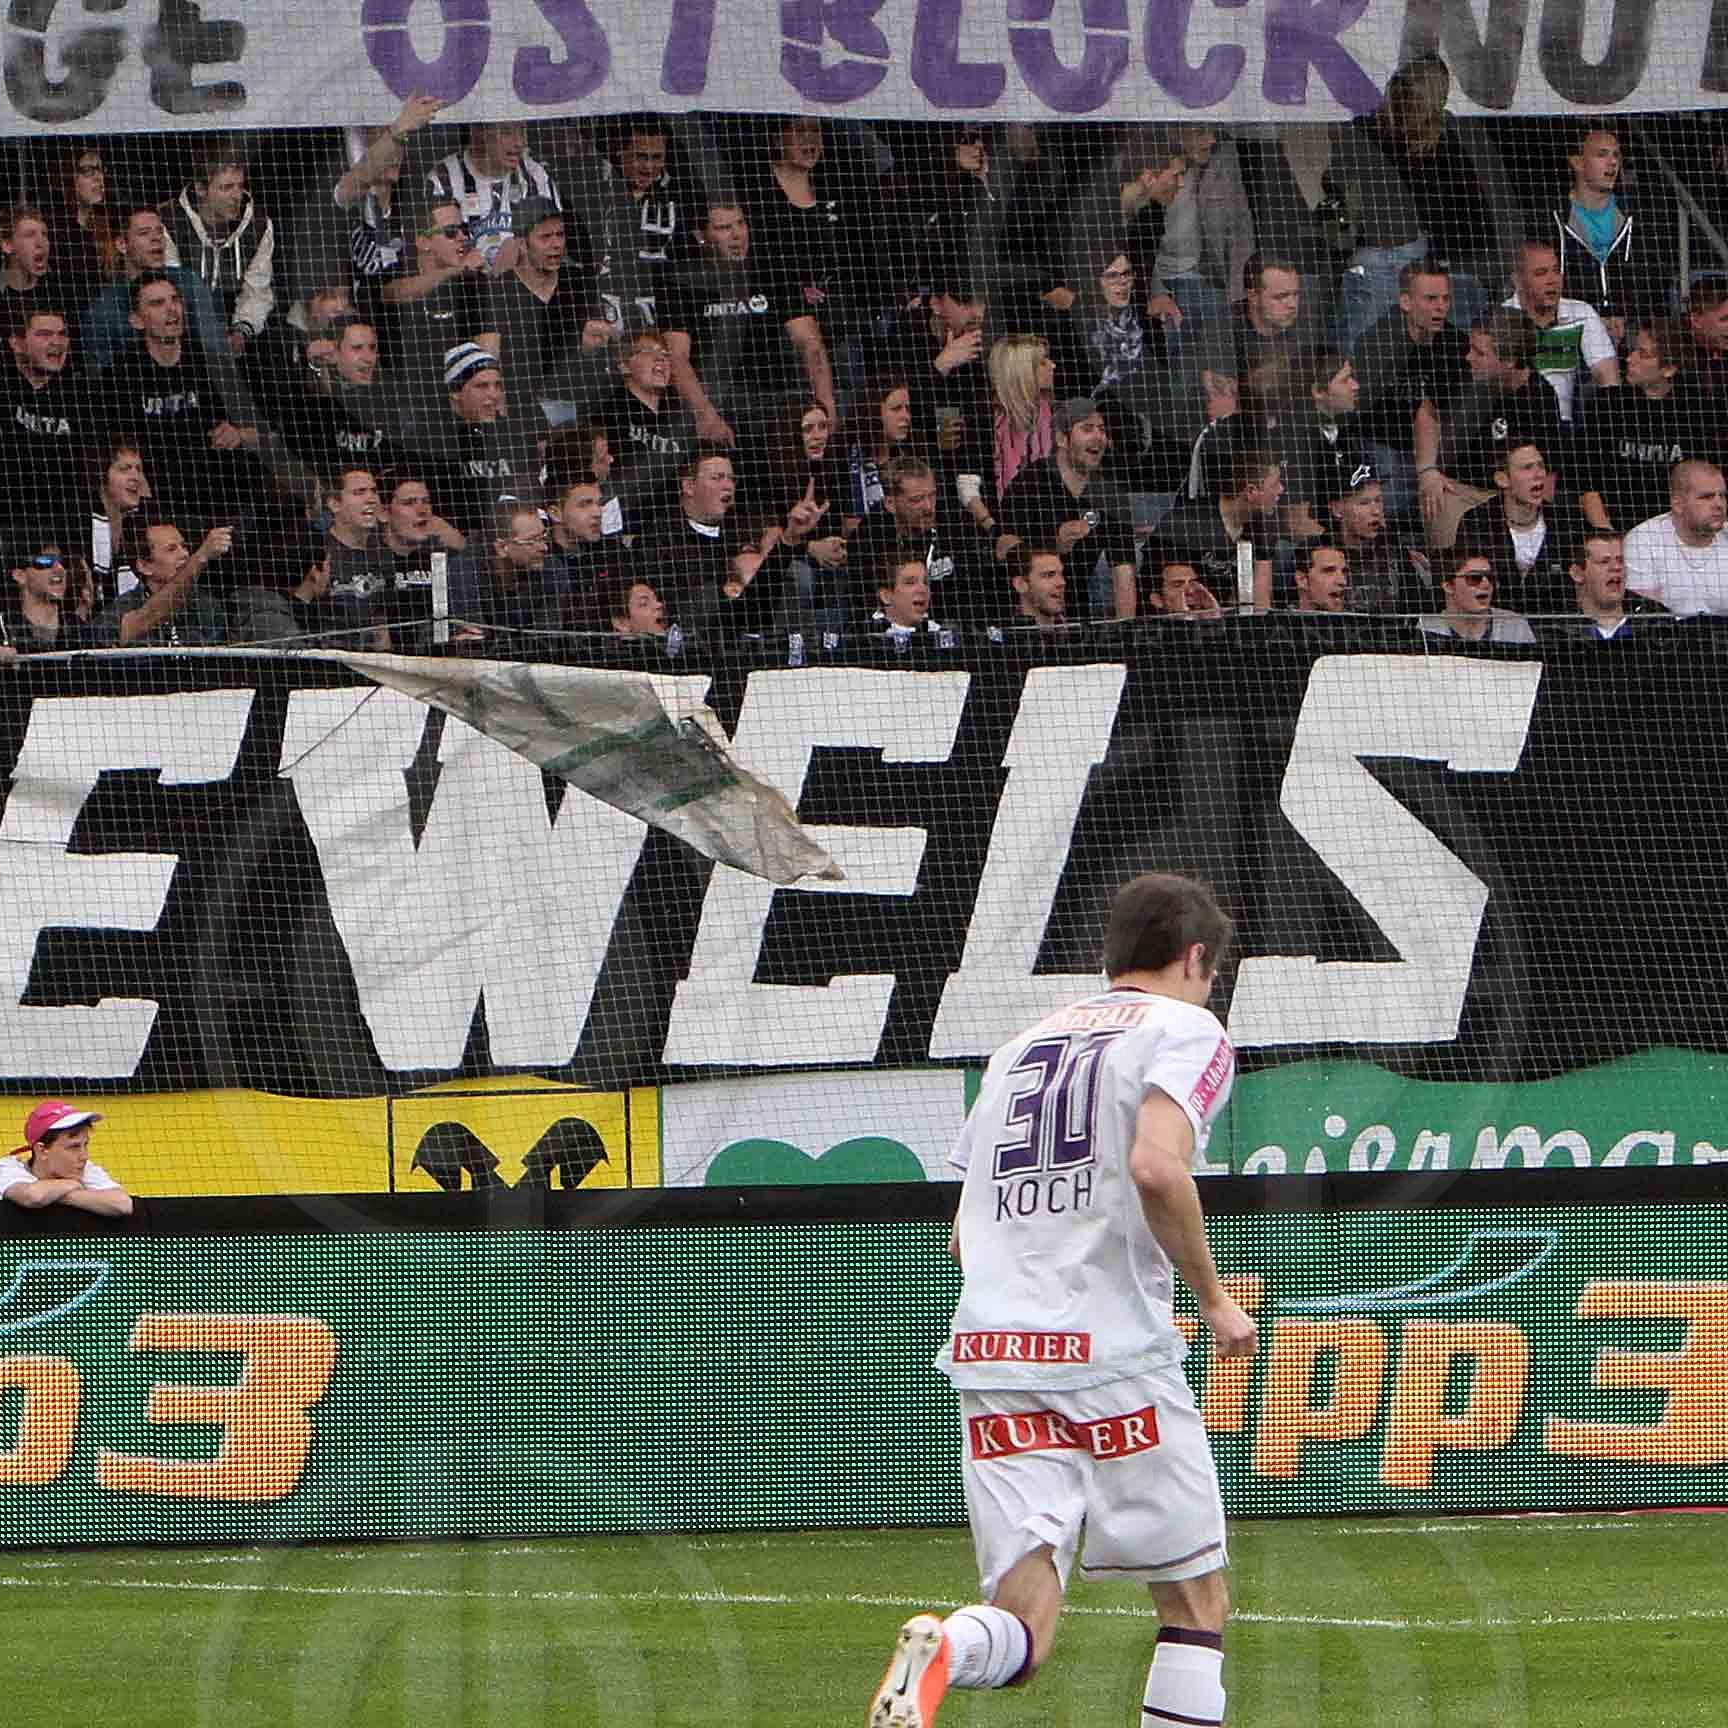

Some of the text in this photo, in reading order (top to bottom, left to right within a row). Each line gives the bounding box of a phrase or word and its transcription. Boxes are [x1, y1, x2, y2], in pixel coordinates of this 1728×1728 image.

[992, 1029, 1125, 1179] 30
[994, 1170, 1093, 1223] KOCH
[955, 1335, 1084, 1362] KURIER
[974, 1412, 1157, 1459] KURER
